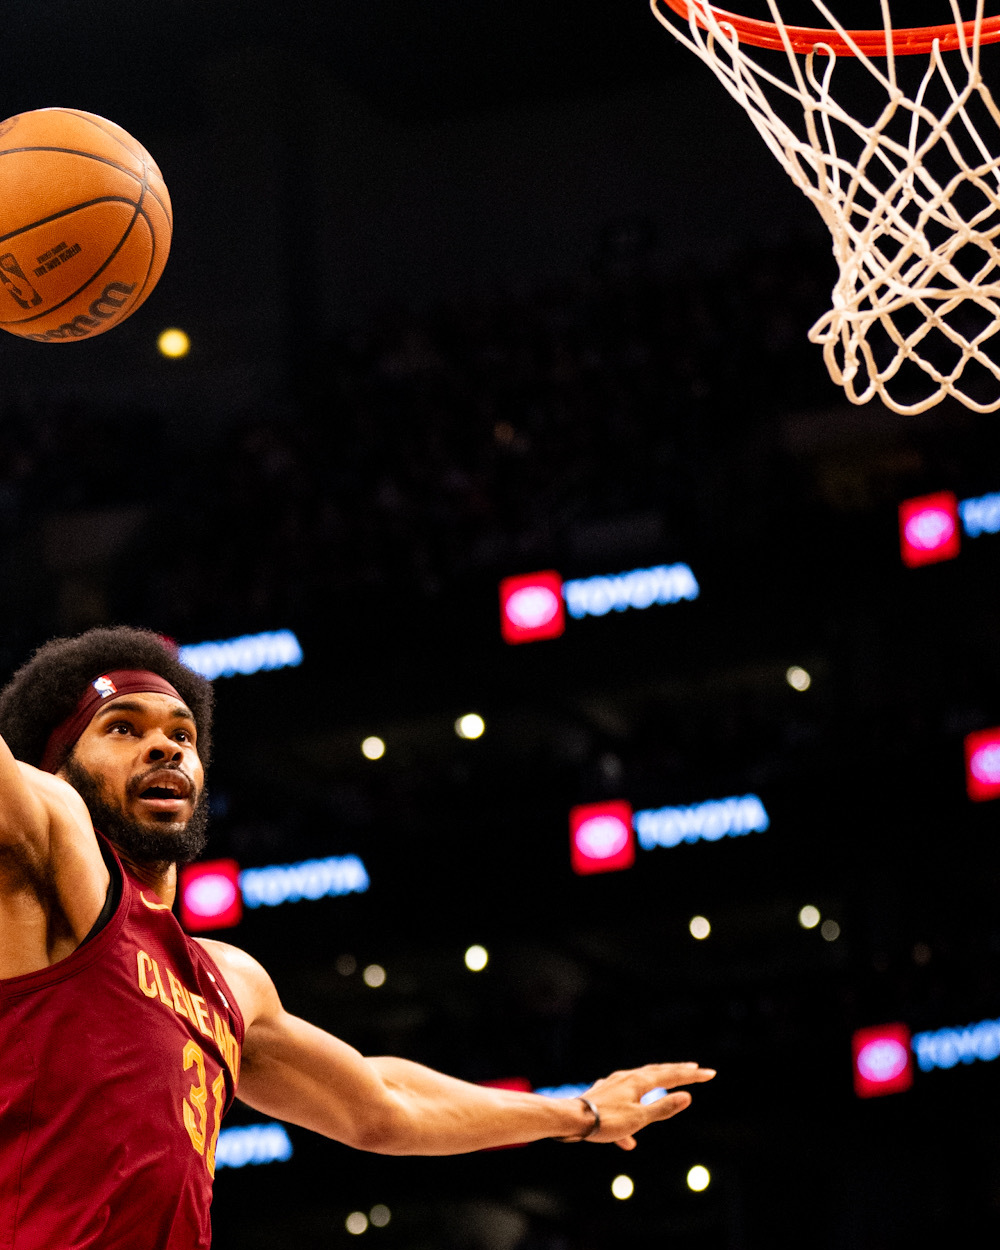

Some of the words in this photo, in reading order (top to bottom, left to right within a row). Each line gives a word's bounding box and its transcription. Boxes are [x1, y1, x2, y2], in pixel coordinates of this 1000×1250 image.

[564, 562, 699, 618] TOYOTA
[633, 794, 769, 850] TOYOTA
[240, 854, 370, 908] TOYOTA
[136, 949, 240, 1086] CLEVEAND
[911, 1018, 1000, 1071] TOYO
[182, 1038, 226, 1180] 31
